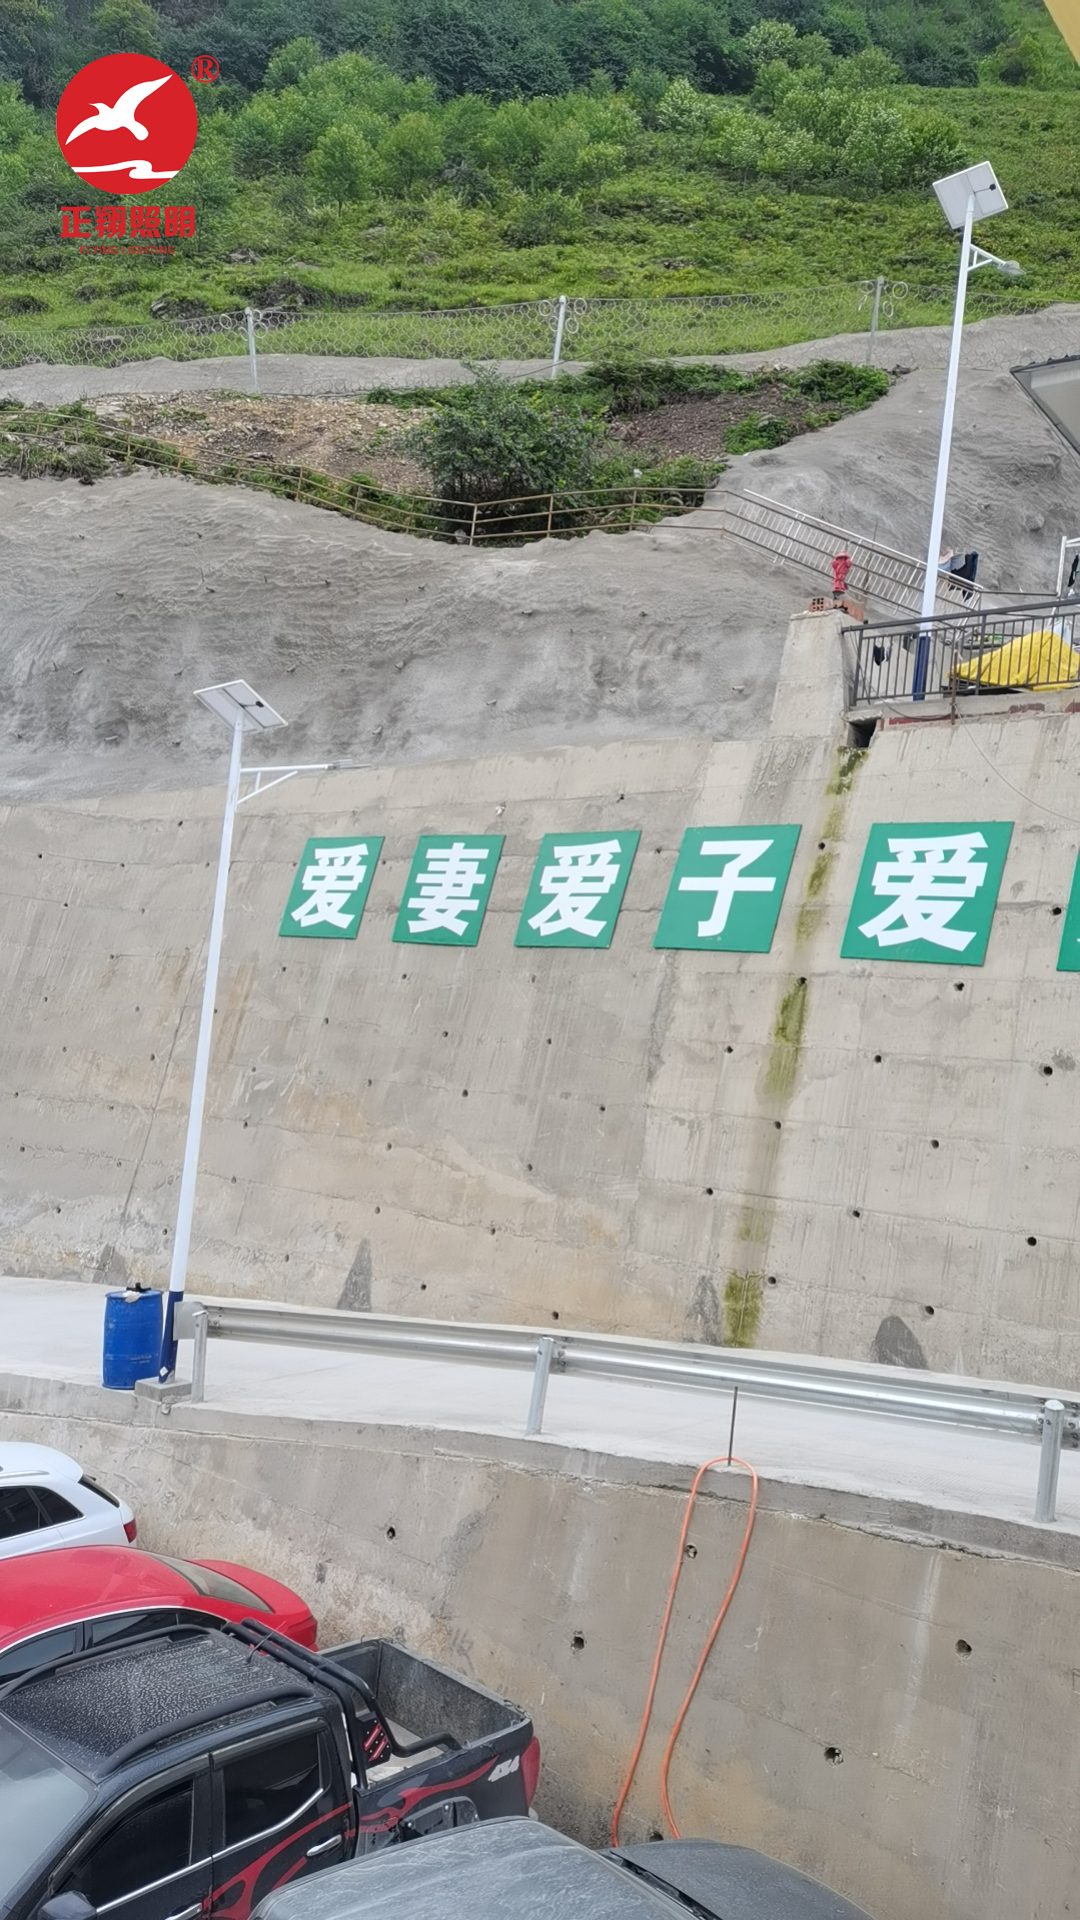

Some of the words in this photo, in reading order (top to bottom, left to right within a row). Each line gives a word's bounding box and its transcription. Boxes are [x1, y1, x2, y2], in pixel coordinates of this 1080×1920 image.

[291, 832, 1080, 950] 爱妻爱子爱
